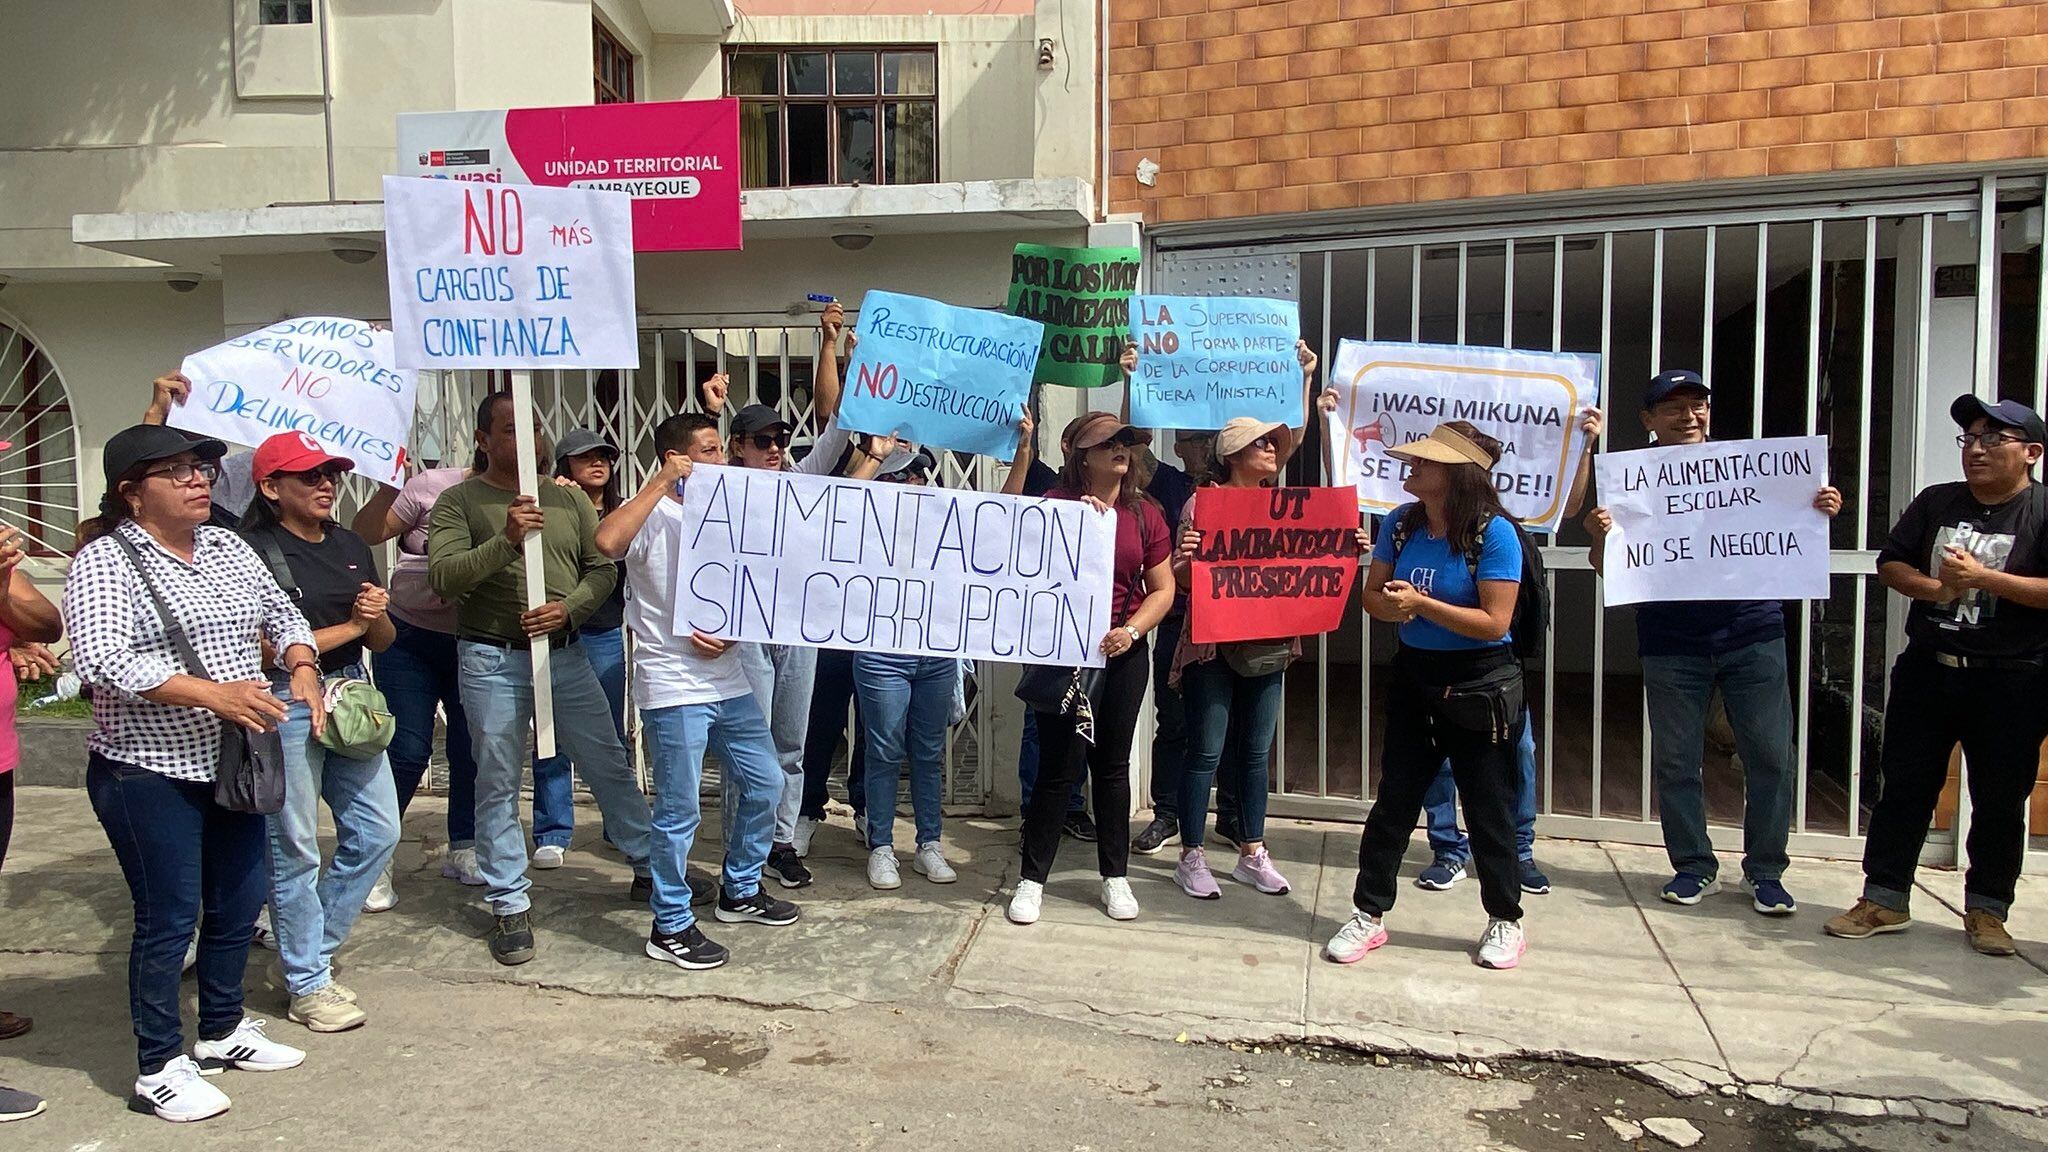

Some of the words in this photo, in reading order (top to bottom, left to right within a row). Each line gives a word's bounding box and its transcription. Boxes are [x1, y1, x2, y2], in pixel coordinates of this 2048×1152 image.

[544, 159, 609, 176] UNIDAD
[613, 156, 723, 174] TERRITORIAL
[464, 188, 524, 256] NO
[548, 219, 593, 247] MÁS
[416, 266, 515, 303] CARGOS
[536, 265, 572, 301] DE
[1012, 254, 1049, 287] POR
[1051, 259, 1100, 293] LOS
[1140, 299, 1174, 326] LA
[1185, 304, 1288, 327] SUPERVISION
[266, 320, 374, 348] SOMOS
[423, 316, 581, 357] CONFIANZA
[869, 307, 1039, 373] REESTRUCTURACIÓN!
[1143, 331, 1179, 355] NO
[1191, 330, 1241, 351] FORMA
[1244, 336, 1286, 353] PARTE
[228, 338, 404, 394] SERVIDORES
[281, 367, 332, 399] NO
[1143, 362, 1162, 378] DE
[1171, 360, 1189, 379] LA
[1195, 358, 1290, 375] CORRUPCION
[854, 362, 898, 400] NO
[896, 378, 1014, 426] DESTRUCCIÓN
[1205, 381, 1285, 404] MINISTRA!
[1372, 392, 1445, 417] ¡WASI
[1453, 399, 1562, 427] MIKUNA
[1361, 457, 1390, 480] SE
[1624, 466, 1649, 492] LA
[1656, 449, 1812, 488] ALIMENTACION
[1269, 488, 1311, 520] UT
[1665, 486, 1762, 515] ESCOLAR
[691, 473, 1085, 582] ALIMENTACIÓN
[1627, 542, 1654, 569] NO
[1663, 536, 1694, 563] SE
[1710, 531, 1803, 558] NEGOCIA
[1210, 566, 1344, 599] PRESENTE
[688, 559, 779, 638] SIN
[800, 571, 1094, 662] CORRUPCIÓN
